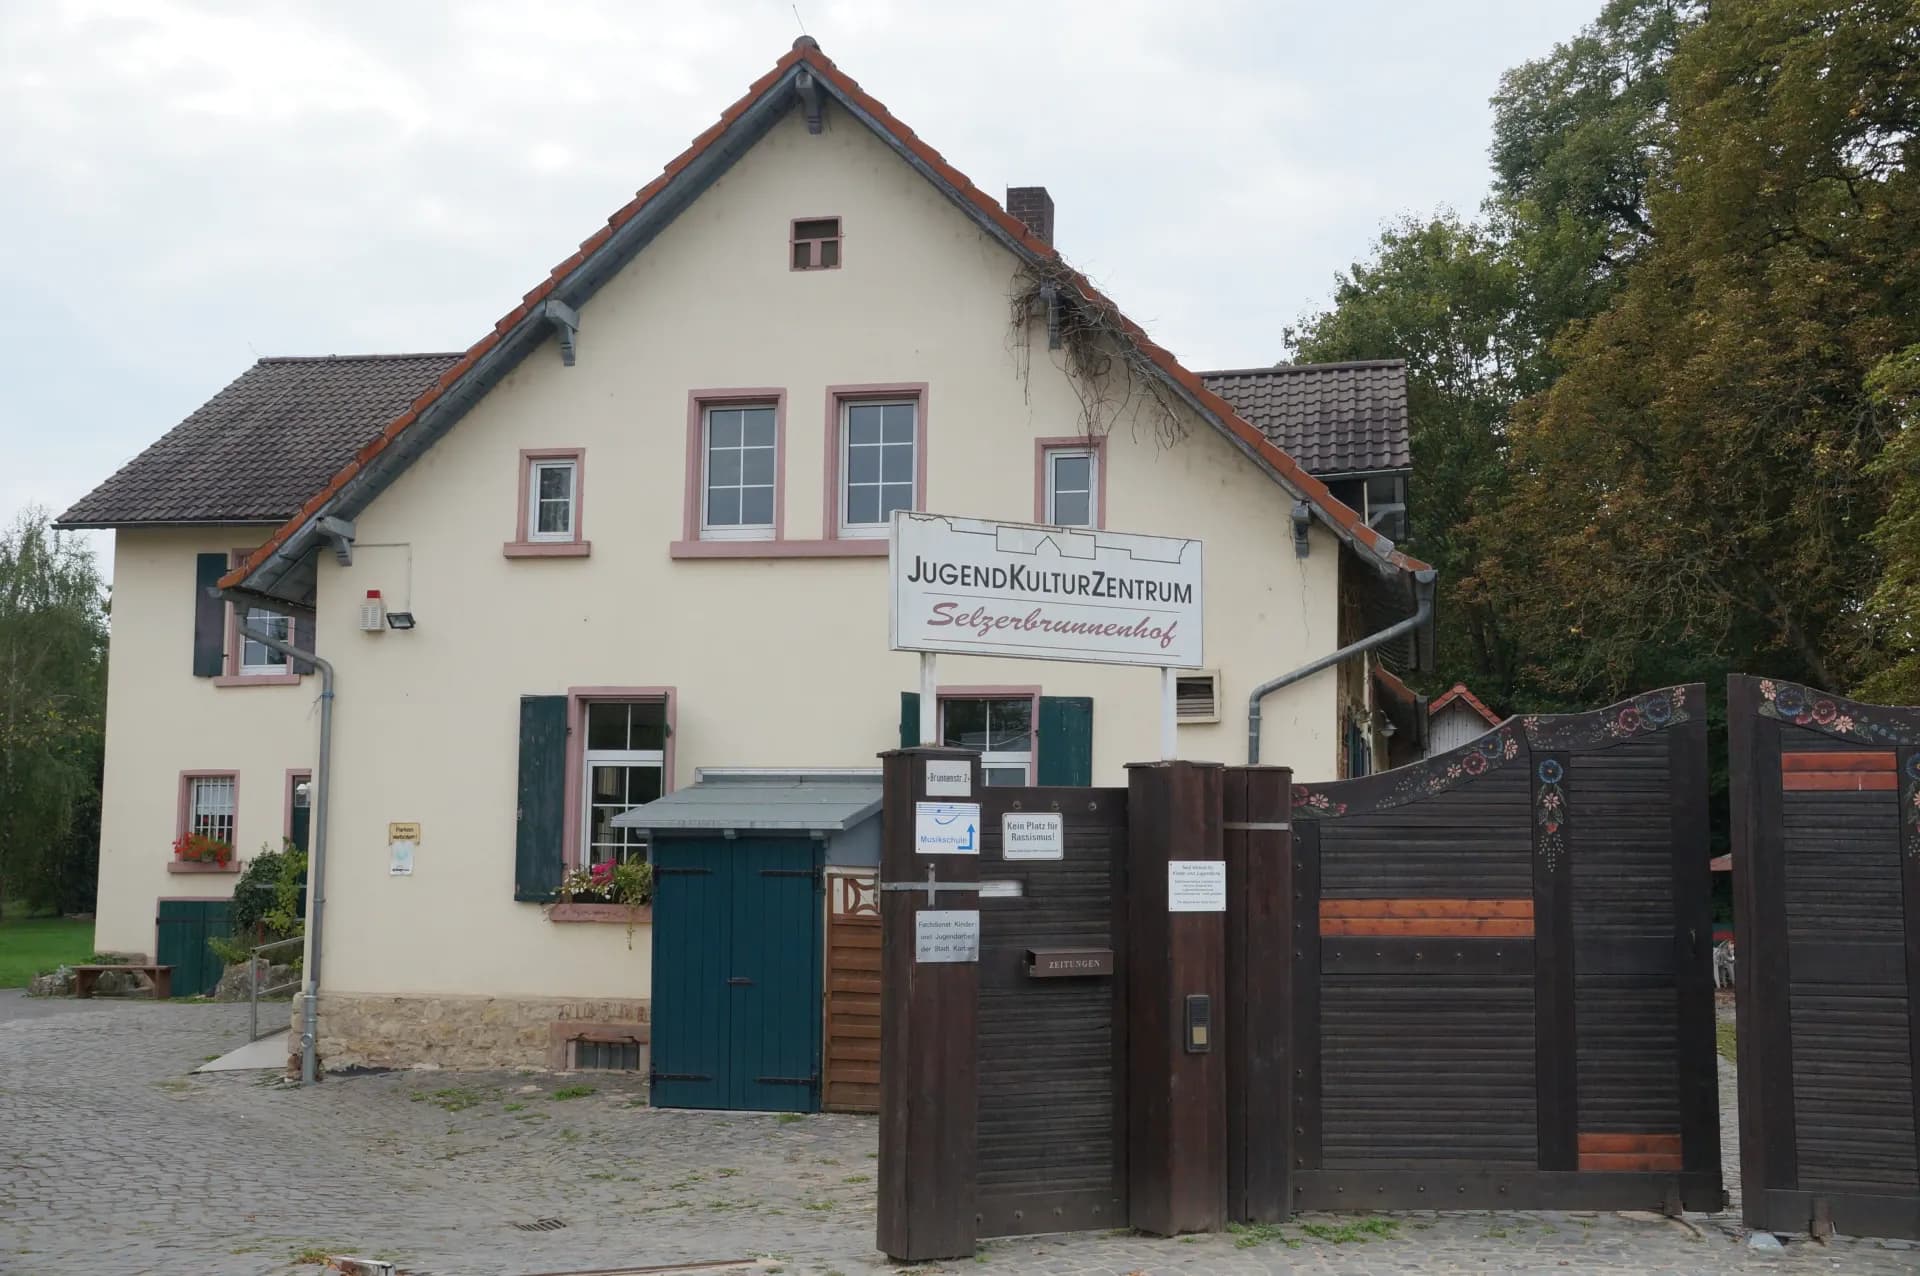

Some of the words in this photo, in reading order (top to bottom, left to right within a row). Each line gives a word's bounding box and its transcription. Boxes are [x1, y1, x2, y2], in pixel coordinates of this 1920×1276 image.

[926, 602, 1178, 649] Selzerbrunnenhof
[1007, 821, 1025, 830] Kein
[1026, 821, 1046, 830] Platz
[1047, 821, 1058, 830] für
[1011, 832, 1055, 841] Rassismus!
[1049, 959, 1102, 969] ZEITUNGEN
